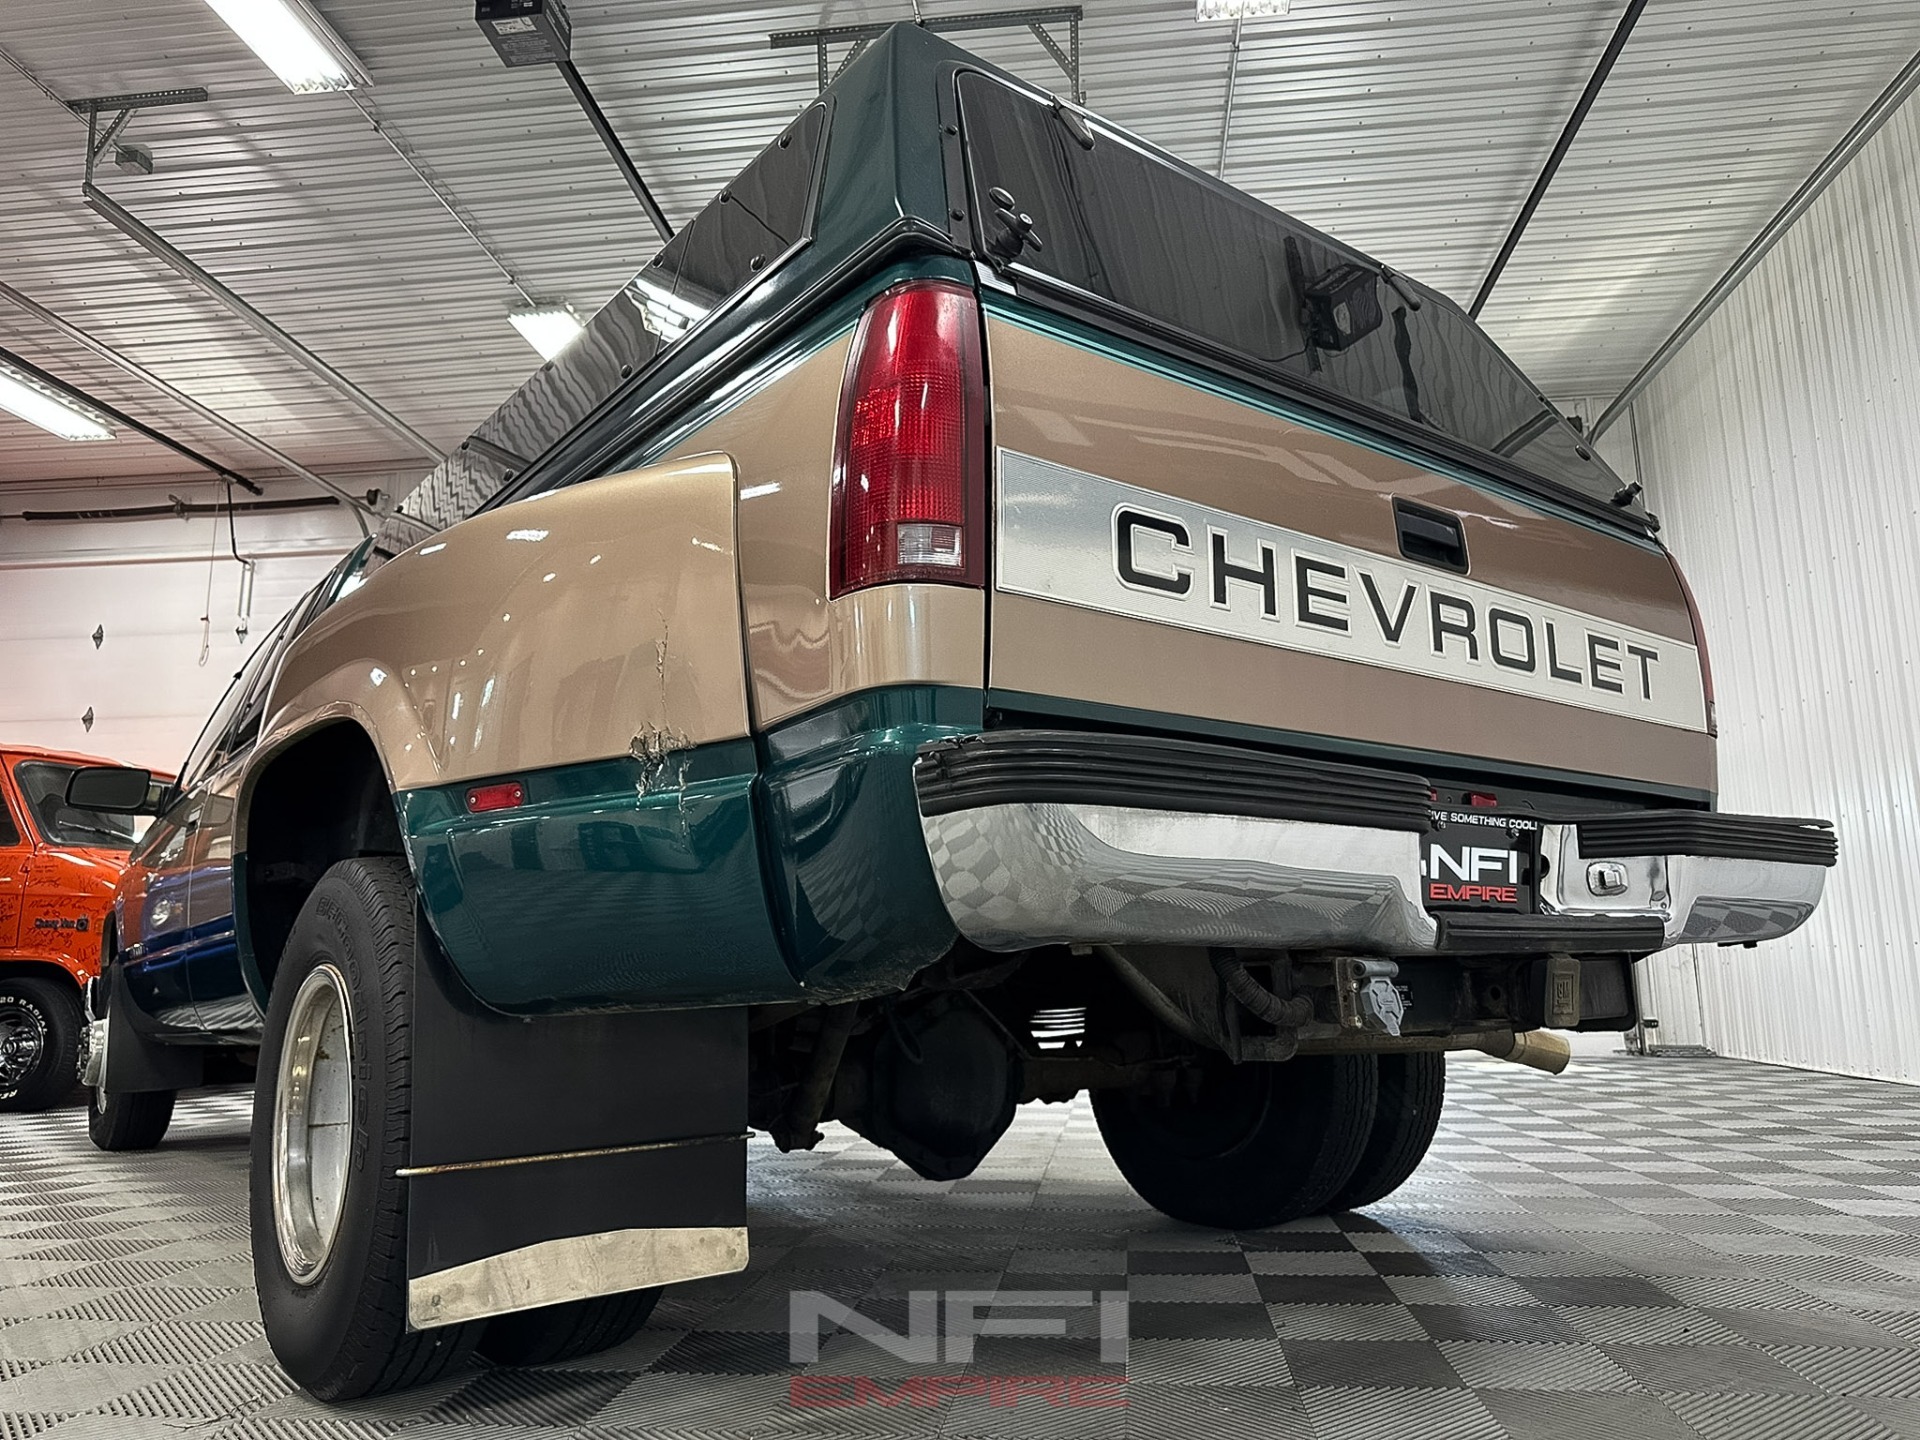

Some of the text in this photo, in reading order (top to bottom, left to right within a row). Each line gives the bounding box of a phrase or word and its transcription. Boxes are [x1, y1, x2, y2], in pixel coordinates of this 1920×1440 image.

[1114, 506, 1660, 700] CHEVROLET
[1428, 810, 1537, 830] IVE SOMETHING COOL!
[1430, 843, 1518, 884] NFI
[1430, 883, 1518, 902] EMPIRE
[19, 999, 48, 1035] RADIAL
